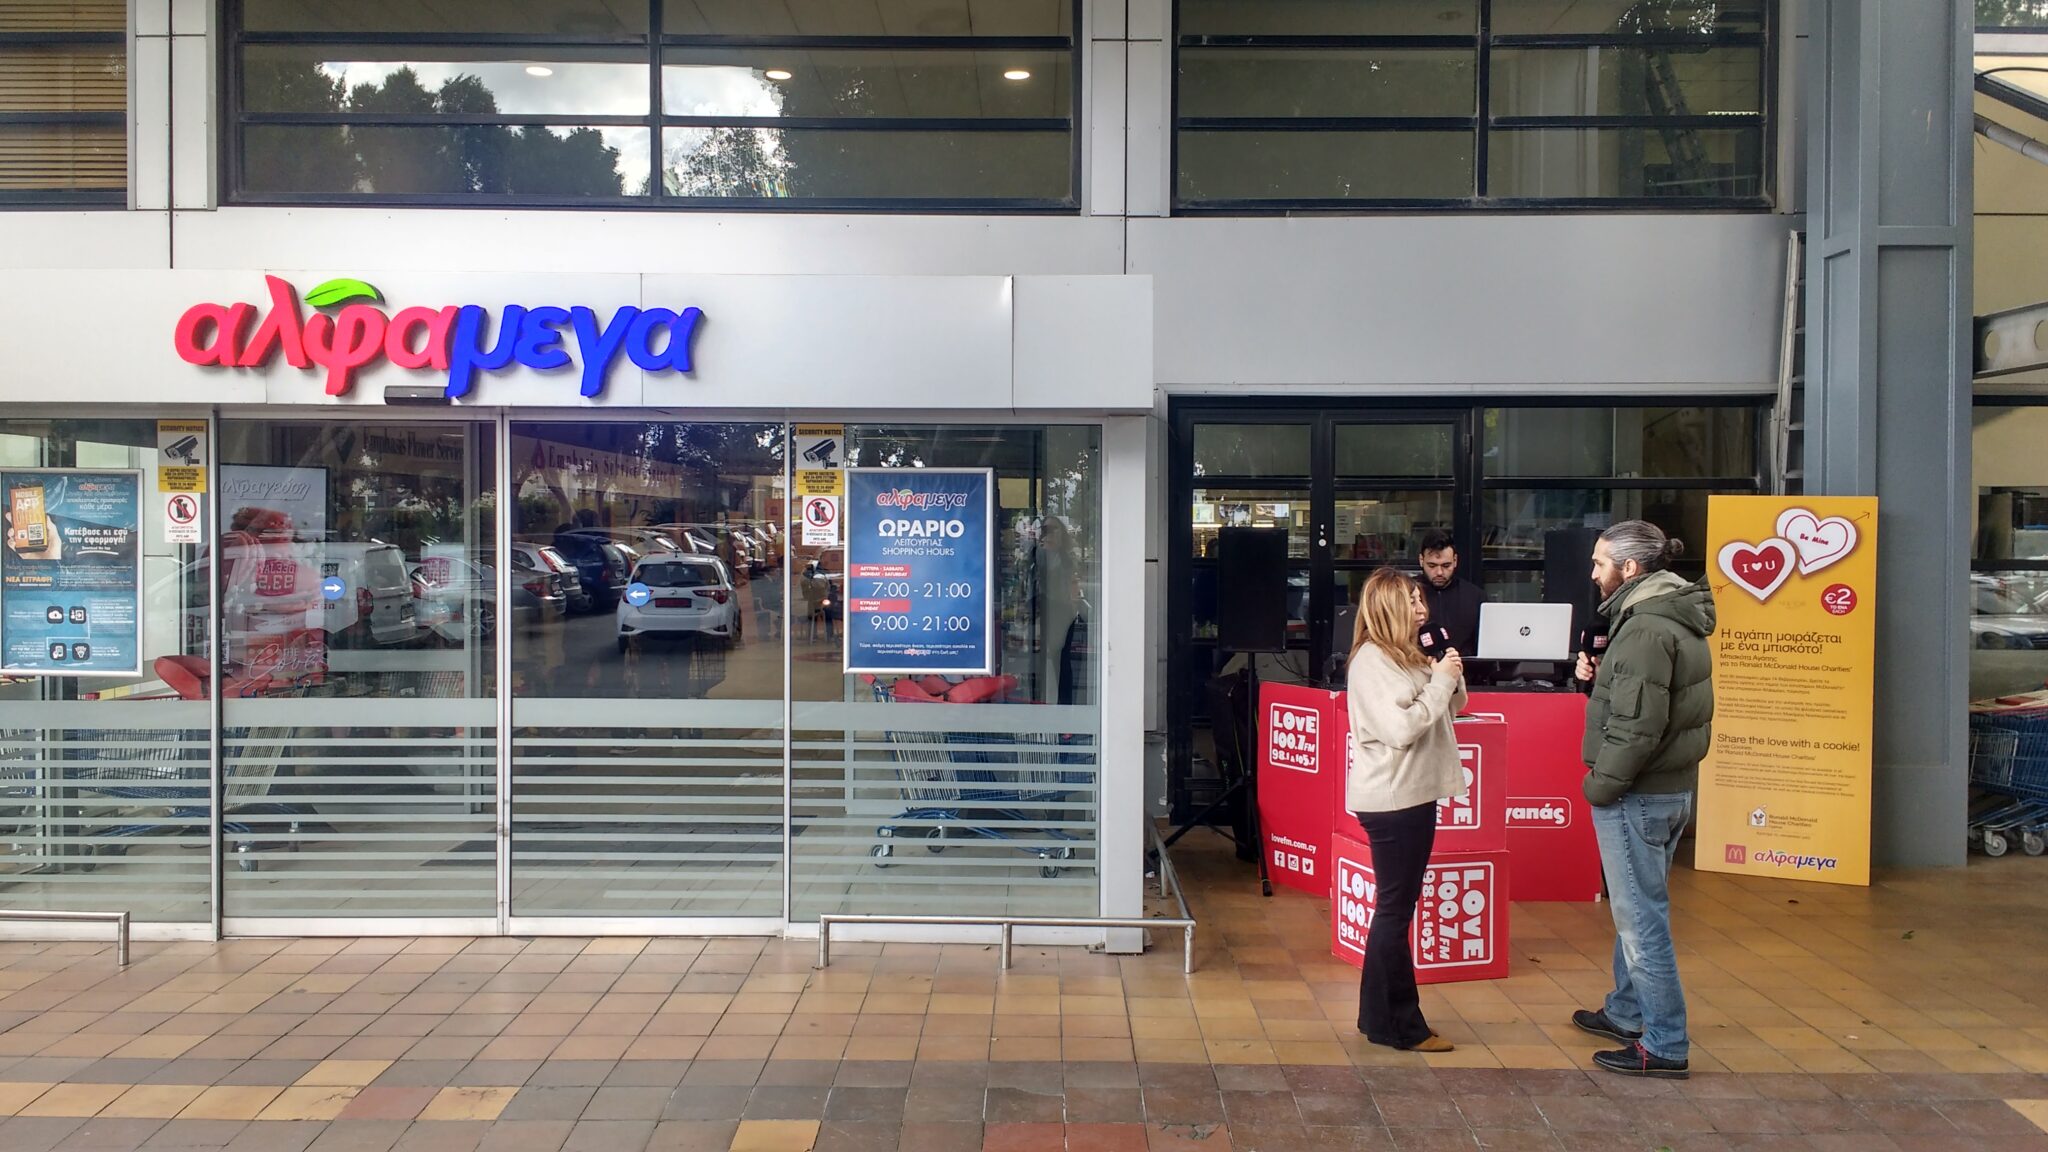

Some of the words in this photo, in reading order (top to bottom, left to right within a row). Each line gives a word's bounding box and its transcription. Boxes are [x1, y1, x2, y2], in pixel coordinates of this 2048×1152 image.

[174, 275, 702, 398] αλφαμεγα
[799, 428, 823, 436] SECURITY
[824, 428, 842, 436] NOTICE
[16, 498, 39, 511] APP
[877, 488, 967, 511] αλφαμεγα
[64, 527, 101, 536] Κατέβασε
[878, 519, 965, 538] ΩΡΑΡΙΟ
[84, 536, 126, 547] εφαρμογή!
[1800, 533, 1809, 541] Be
[1812, 537, 1829, 546] Mine
[882, 547, 924, 556] SHOPPING
[926, 548, 955, 556] HOURS
[1742, 563, 1749, 573] I
[1765, 560, 1776, 570] U
[872, 582, 910, 598] 7:00
[923, 583, 971, 598] 21:00
[1824, 588, 1851, 605] €2
[871, 615, 909, 631] 9:00
[922, 616, 970, 631] 21:00
[1520, 626, 1531, 637] hp
[1721, 628, 1731, 639] Η
[1734, 629, 1773, 643] αγάπη
[1776, 631, 1842, 645] μοιράζεται
[1720, 643, 1735, 652] με
[1738, 641, 1759, 651] ένα
[1763, 643, 1823, 655] μπισκότο!
[1739, 661, 1763, 669] Ronald
[1764, 662, 1798, 671] McDonald
[1273, 710, 1316, 733] LOVE
[1717, 734, 1746, 744] Share
[1749, 736, 1765, 745] the
[1767, 737, 1789, 746] love
[1791, 739, 1811, 748] with
[1823, 741, 1860, 751] cookie!
[1271, 832, 1316, 854] lovefm.com.cy
[1754, 850, 1837, 870] αλφαμεγα
[1341, 868, 1376, 903] LOV
[1341, 895, 1375, 928] 100.7
[1462, 869, 1486, 960] LOVE
